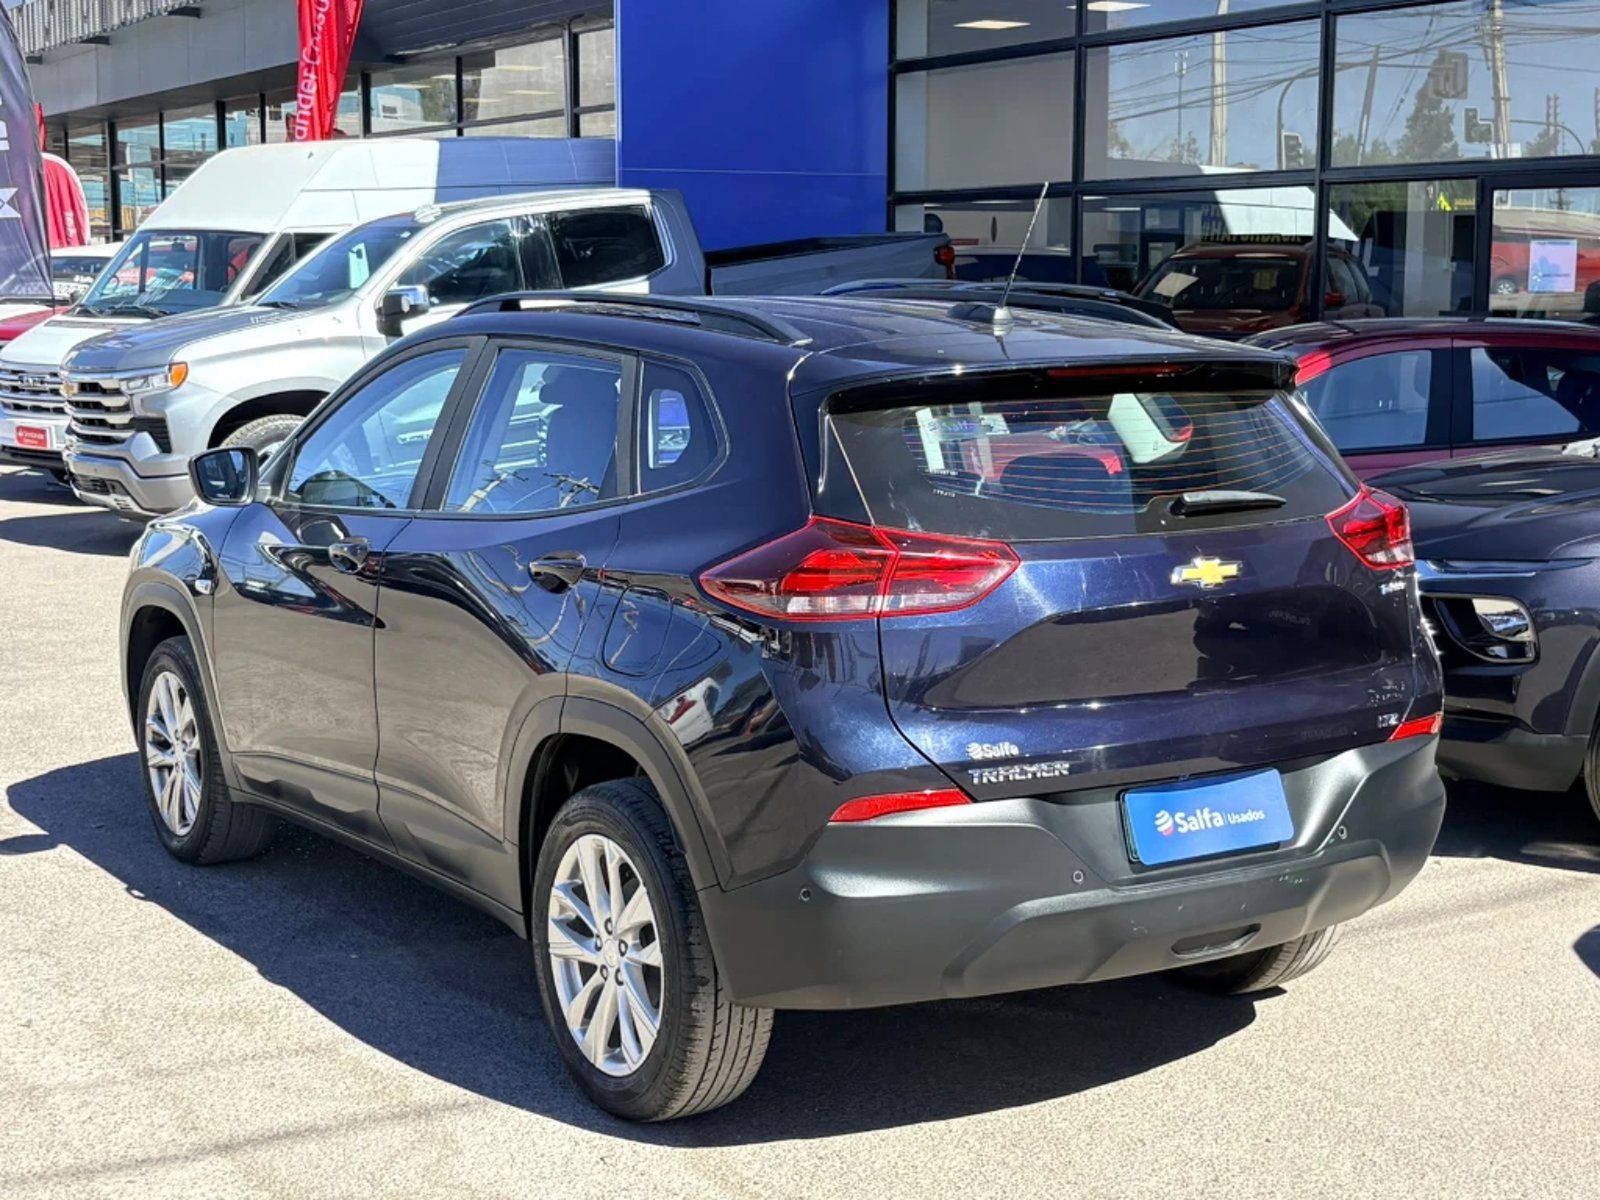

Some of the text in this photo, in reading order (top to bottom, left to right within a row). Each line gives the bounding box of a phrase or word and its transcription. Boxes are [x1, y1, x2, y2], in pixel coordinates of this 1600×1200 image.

[981, 741, 1020, 759] Salfa
[967, 760, 1070, 784] TRACKER
[1174, 807, 1266, 834] Salfa Usados
